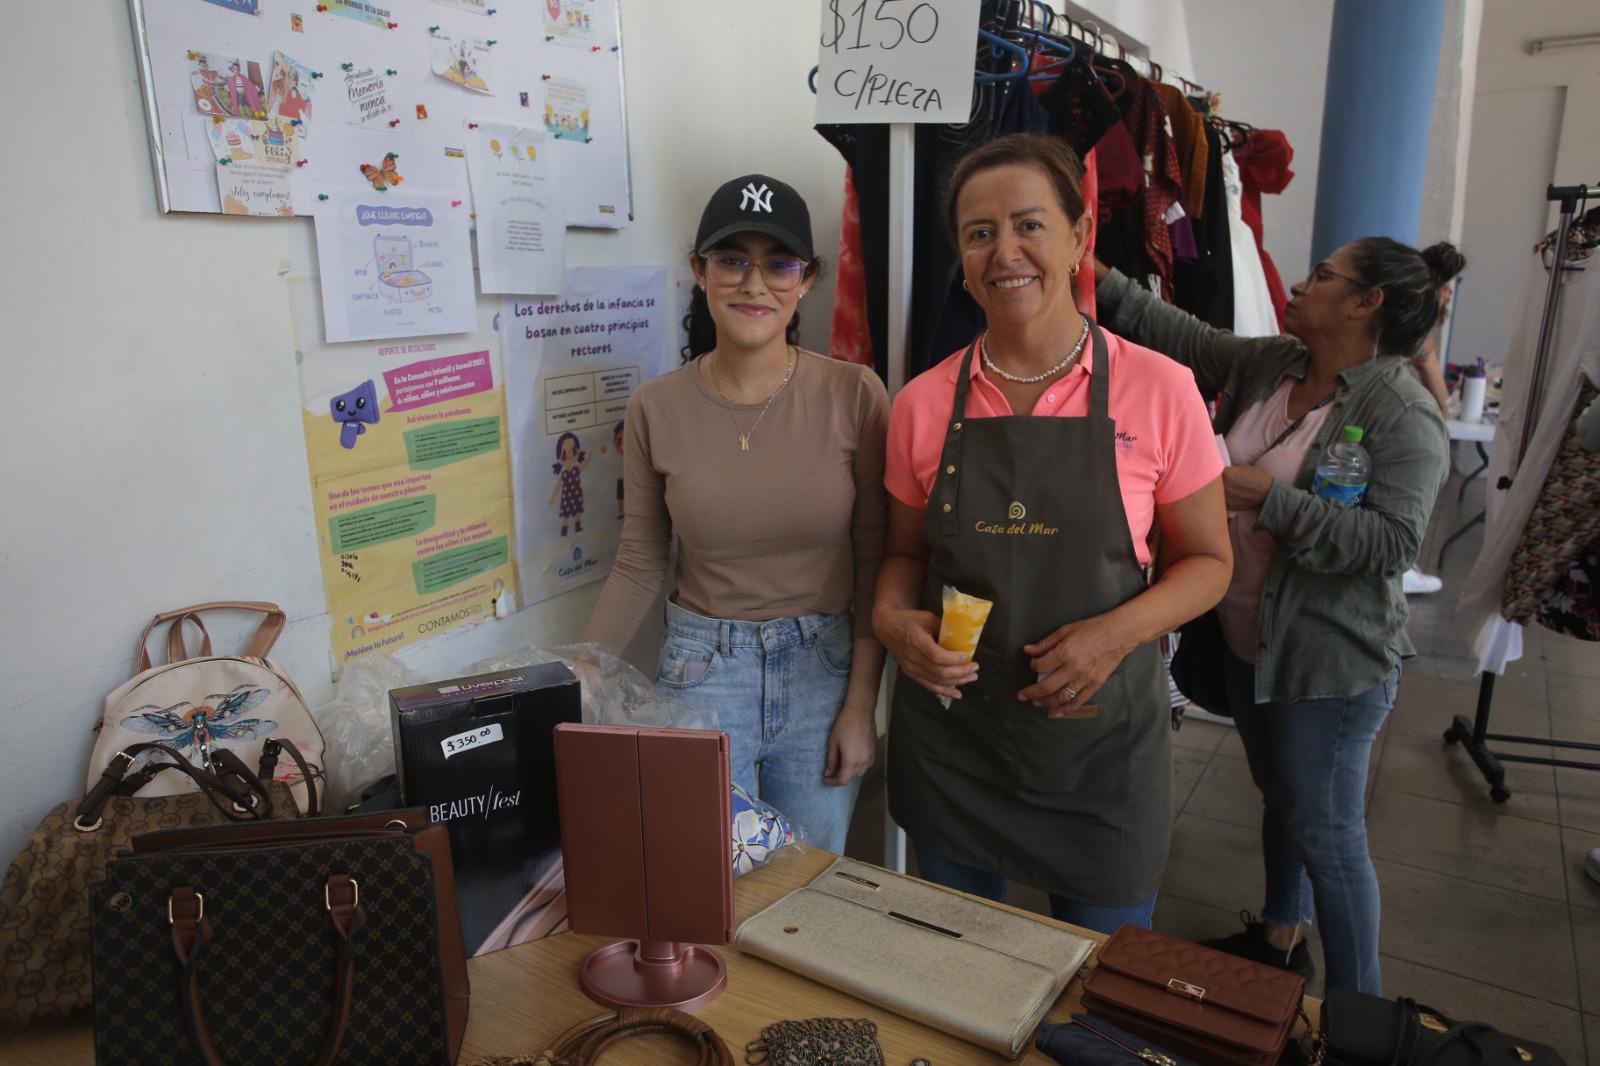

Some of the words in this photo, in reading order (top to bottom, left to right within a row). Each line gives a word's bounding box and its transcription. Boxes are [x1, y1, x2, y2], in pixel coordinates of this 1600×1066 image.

[820, 0, 939, 54] $150
[834, 64, 942, 112] C/PIEZA
[514, 304, 533, 317] Los
[537, 301, 581, 316] derechos
[583, 300, 594, 312] de
[596, 300, 606, 310] la
[608, 298, 644, 310] infancia
[646, 298, 656, 307] se
[526, 326, 558, 340] basan
[560, 326, 572, 336] en
[574, 321, 606, 335] cuatro
[608, 319, 650, 335] principios
[570, 344, 612, 358] rectores
[360, 484, 380, 494] temas
[381, 482, 392, 491] que
[975, 520, 1004, 536] Casa
[1006, 522, 1026, 536] del
[1028, 522, 1060, 536] Mar
[558, 566, 576, 578] Casa
[418, 608, 470, 634] CONTAMOS
[374, 640, 382, 649] tu
